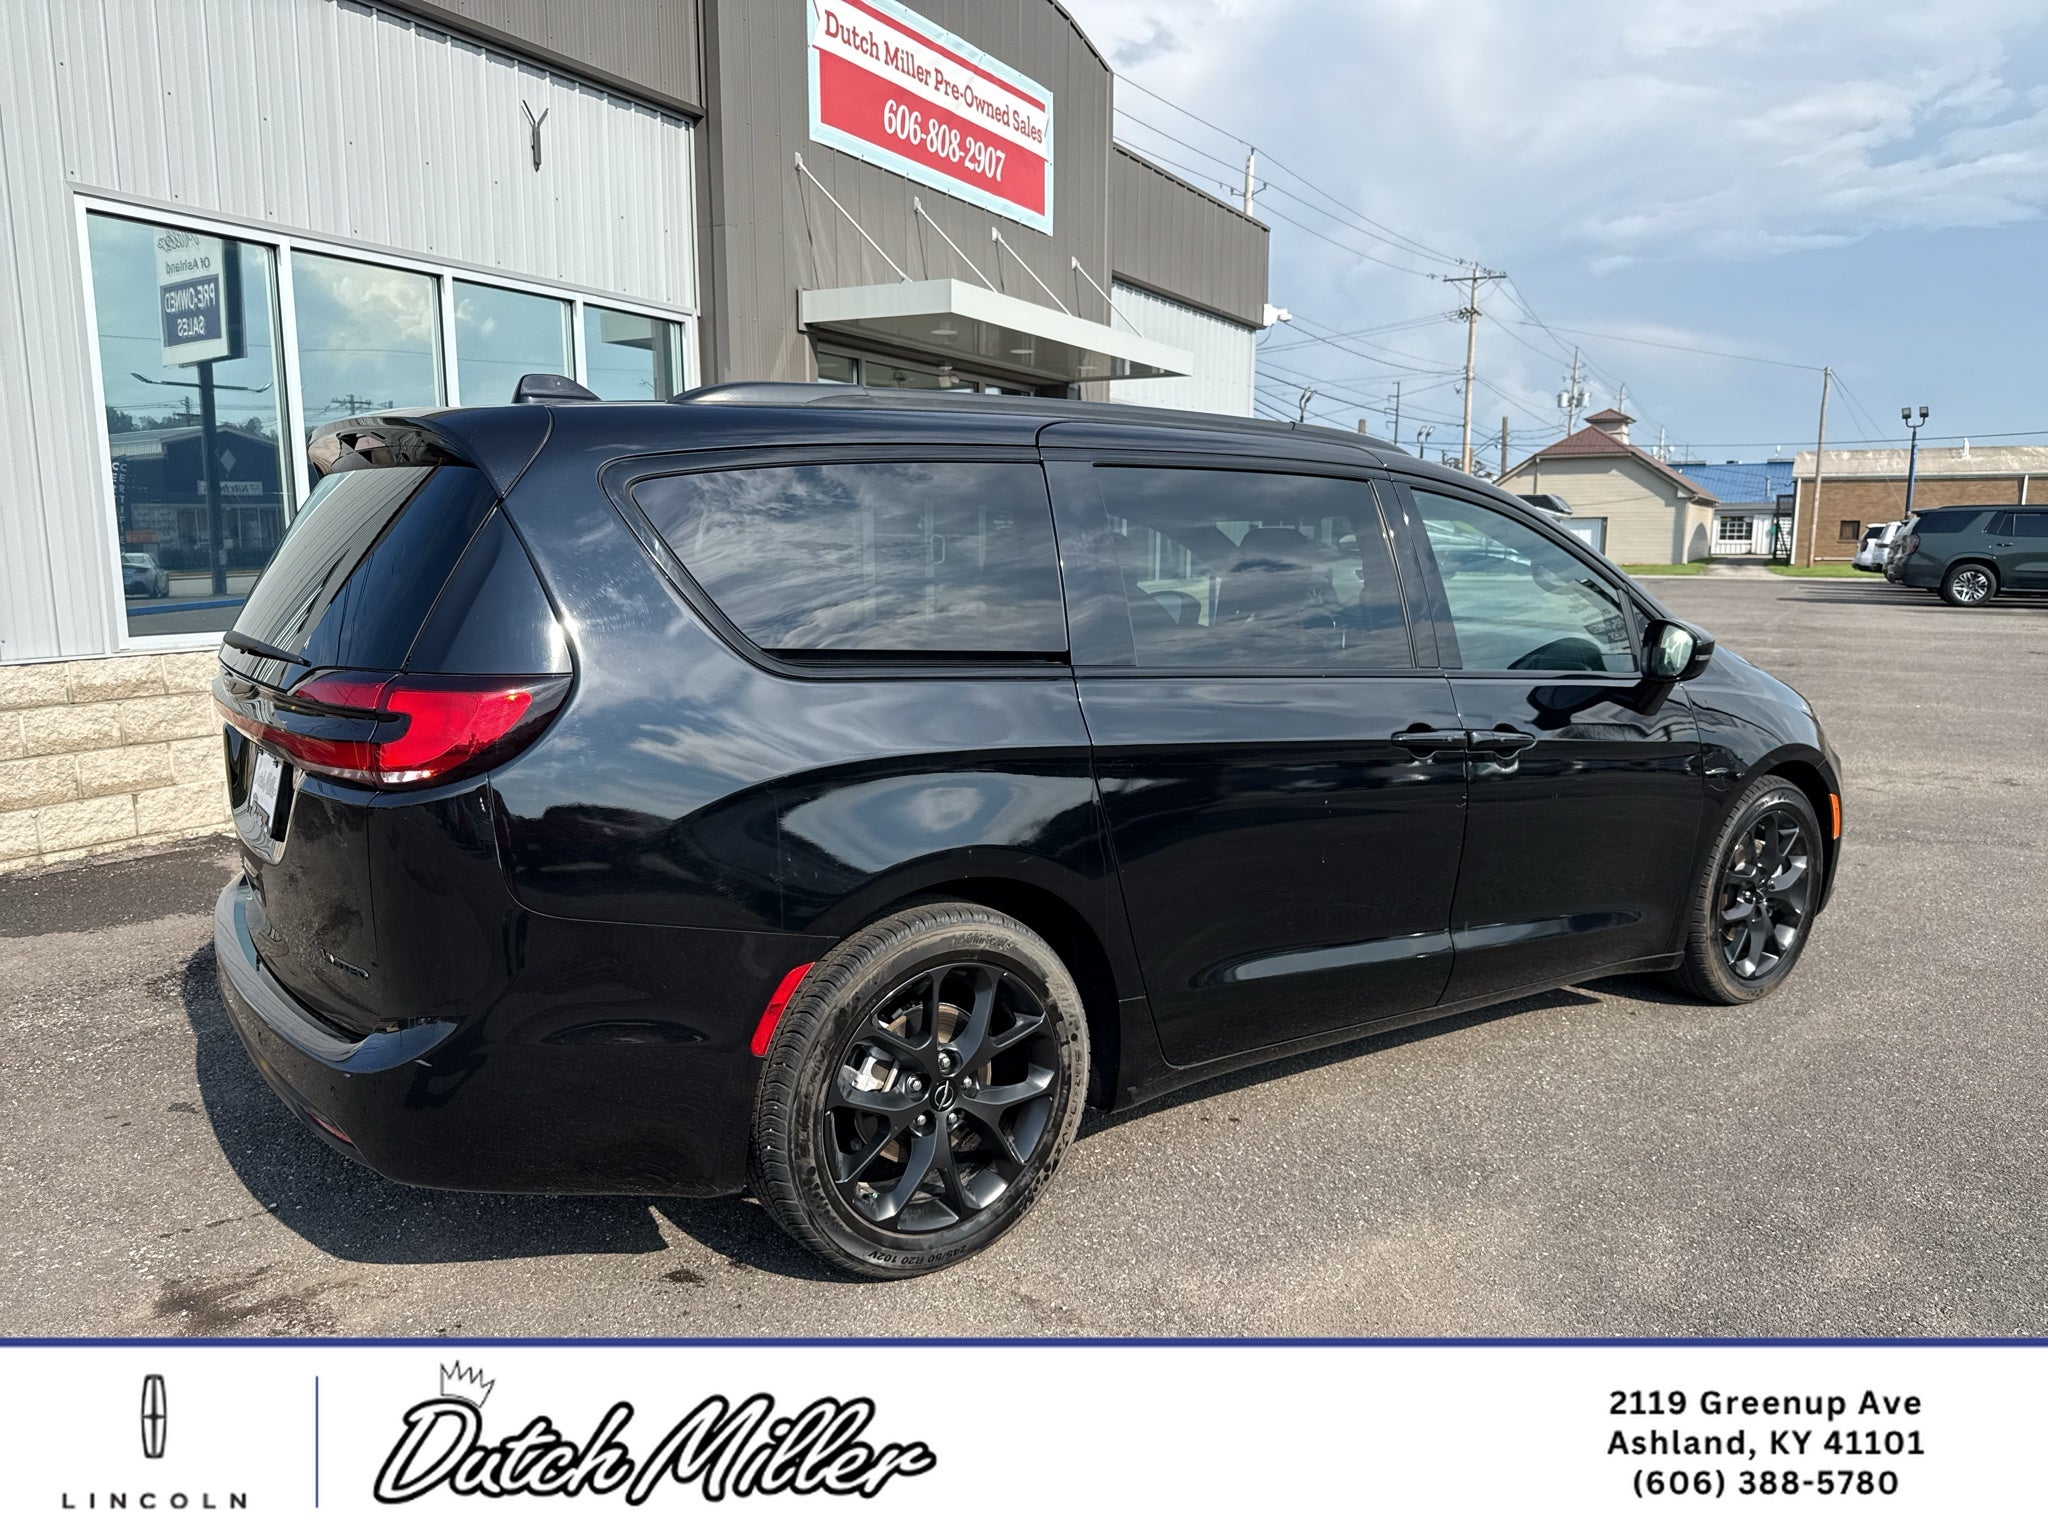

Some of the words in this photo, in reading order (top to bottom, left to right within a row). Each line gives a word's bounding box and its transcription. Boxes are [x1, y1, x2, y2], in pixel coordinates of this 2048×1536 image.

[824, 10, 880, 61] Dutch
[883, 41, 932, 86] Miller
[934, 67, 1010, 126] Pre-Owned
[1012, 110, 1042, 144] Sales
[883, 99, 1006, 182] 606-808-2907
[867, 1250, 898, 1264] 102V
[901, 1256, 925, 1265] R20
[927, 1245, 967, 1263] 245/50
